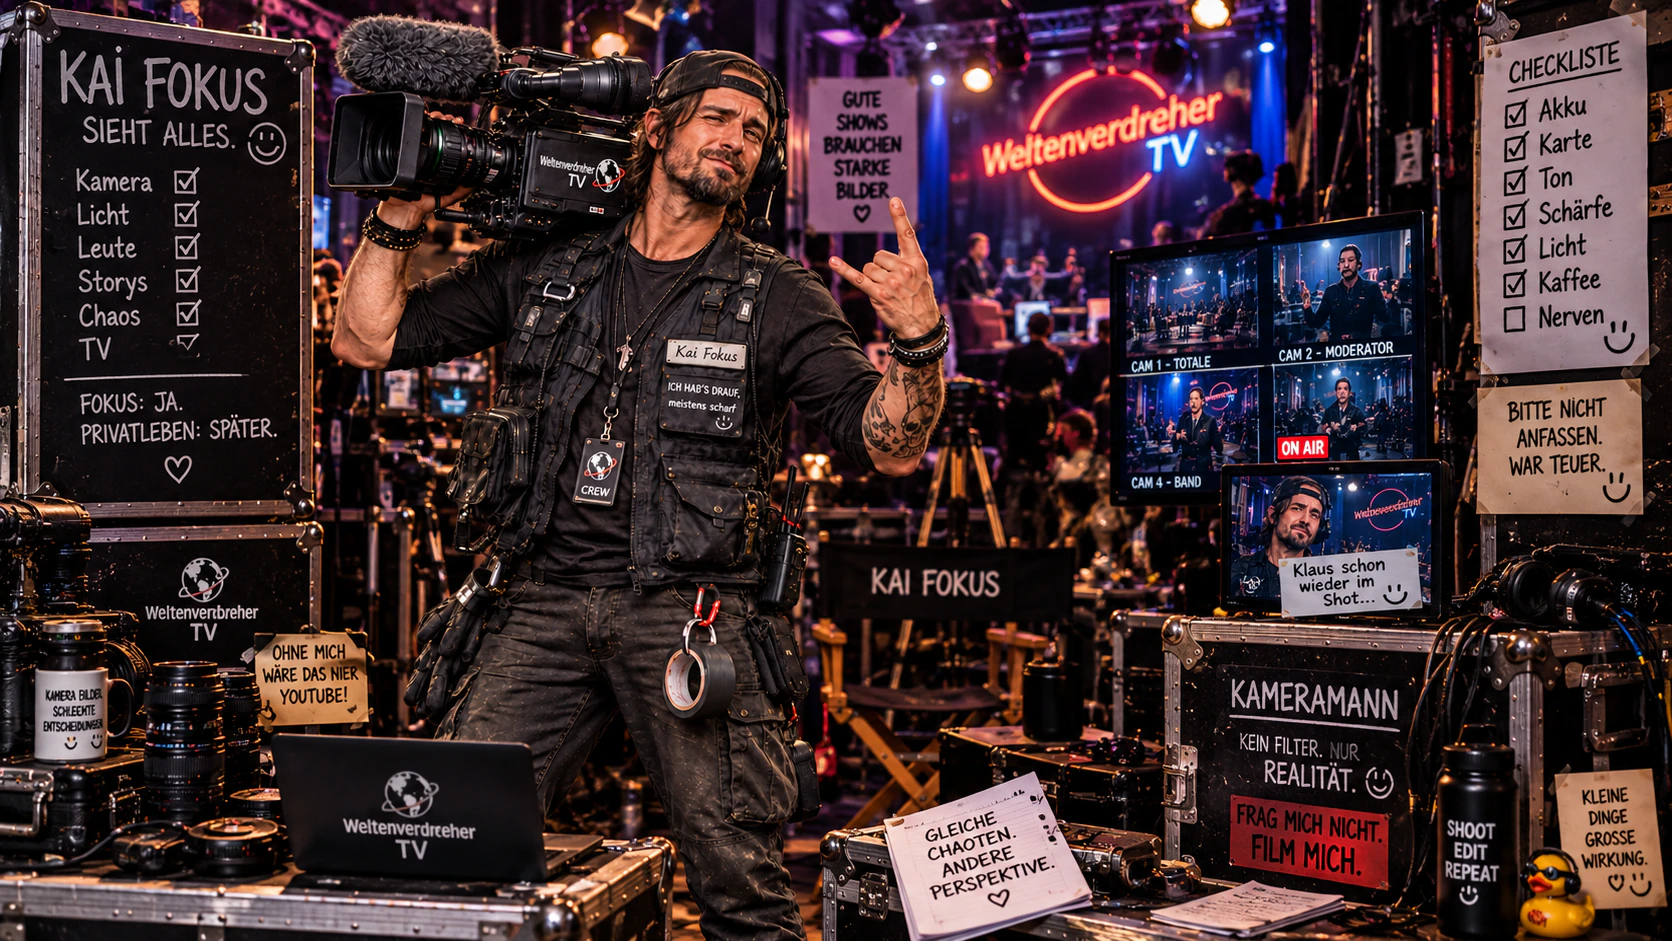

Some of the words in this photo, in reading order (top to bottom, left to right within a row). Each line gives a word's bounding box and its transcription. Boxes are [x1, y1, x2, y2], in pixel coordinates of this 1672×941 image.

[1509, 40, 1620, 84] CHECKLISTE
[144, 57, 267, 115] FOKUS
[843, 91, 882, 109] GUTE
[1539, 96, 1587, 123] Akku
[83, 116, 152, 145] SIEHT
[163, 121, 236, 149] ALLES.
[837, 114, 889, 132] SHOWS
[982, 92, 1224, 177] Weltenverdreher
[824, 136, 902, 155] BRAUCHEN
[1146, 130, 1199, 173] TV
[1540, 129, 1593, 156] Karte
[76, 168, 153, 192] Kamera
[834, 160, 891, 177] STARKE
[1539, 167, 1573, 190] Ton
[568, 173, 587, 189] TV
[836, 182, 890, 200] BILDER
[78, 203, 130, 226] Licht
[1539, 195, 1614, 225] Schärfe
[78, 235, 137, 259] Leute
[1539, 233, 1587, 260] Licht
[79, 270, 148, 301] Storys
[1539, 268, 1601, 294] Kaffee
[79, 304, 141, 327] Chaos
[1539, 305, 1604, 329] Nerven
[79, 337, 111, 361] TV
[675, 345, 698, 359] Kai
[703, 347, 738, 362] Fokus
[1279, 349, 1302, 362] CAM
[1306, 348, 1313, 361] 2
[1325, 342, 1394, 358] MODERATOR
[1131, 360, 1153, 373] CAM
[1156, 359, 1162, 372] 1
[1174, 356, 1211, 370] TOTALE
[668, 382, 682, 392] ICH
[80, 392, 144, 415] FOKUS:
[154, 391, 183, 413] JA.
[668, 399, 707, 411] meistens
[1507, 400, 1552, 423] BITTE
[80, 421, 200, 445] PRIVATLEBEN:
[209, 414, 278, 441] SPÄTER.
[1517, 425, 1603, 449] ANFASSEN.
[1282, 441, 1300, 455] ON
[1303, 440, 1325, 455] AIR
[1509, 456, 1544, 476] WAR
[1549, 453, 1606, 475] TEUER.
[581, 485, 611, 497] CREW
[1131, 476, 1154, 490] CAM
[1156, 476, 1164, 489] 4
[1174, 476, 1202, 489] BAND
[1293, 563, 1335, 578] Klaus
[1342, 558, 1386, 573] schon
[871, 567, 912, 596] KAI
[922, 569, 1000, 598] FOKUS
[1300, 577, 1350, 593] wieder
[1357, 575, 1375, 588] im
[1324, 591, 1376, 607] Shot...
[190, 623, 218, 641] TV
[273, 644, 309, 662] OHNE
[314, 643, 346, 660] MICH
[303, 667, 327, 683] DAS
[330, 665, 359, 682] NIER
[280, 686, 349, 705] YOUTUBE!
[1231, 679, 1398, 721] KAMERAMANN
[1240, 733, 1269, 753] KEIN
[1275, 735, 1323, 759] FILTER.
[1330, 742, 1360, 762] NUR
[1264, 760, 1356, 793] REALITÄT.
[1582, 787, 1629, 805] KLEINE
[925, 811, 997, 842] GLEICHE
[1237, 804, 1278, 829] FRAG
[1285, 810, 1323, 836] MICH
[1330, 817, 1383, 844] NICHT.
[1589, 809, 1628, 826] DINGE
[1447, 820, 1496, 840] SHOOT
[1585, 830, 1636, 848] GROSSE
[395, 839, 428, 860] TV
[928, 827, 1017, 861] CHAOTEN.
[1252, 834, 1295, 867] FILM
[1303, 842, 1362, 877] MICH.
[1454, 842, 1488, 861] EDIT
[942, 846, 1015, 879] ANDERE
[1581, 851, 1648, 869] WIRKUNG.
[929, 857, 1055, 901] PERSPEKTIVE.
[1445, 861, 1500, 883] REPEAT
